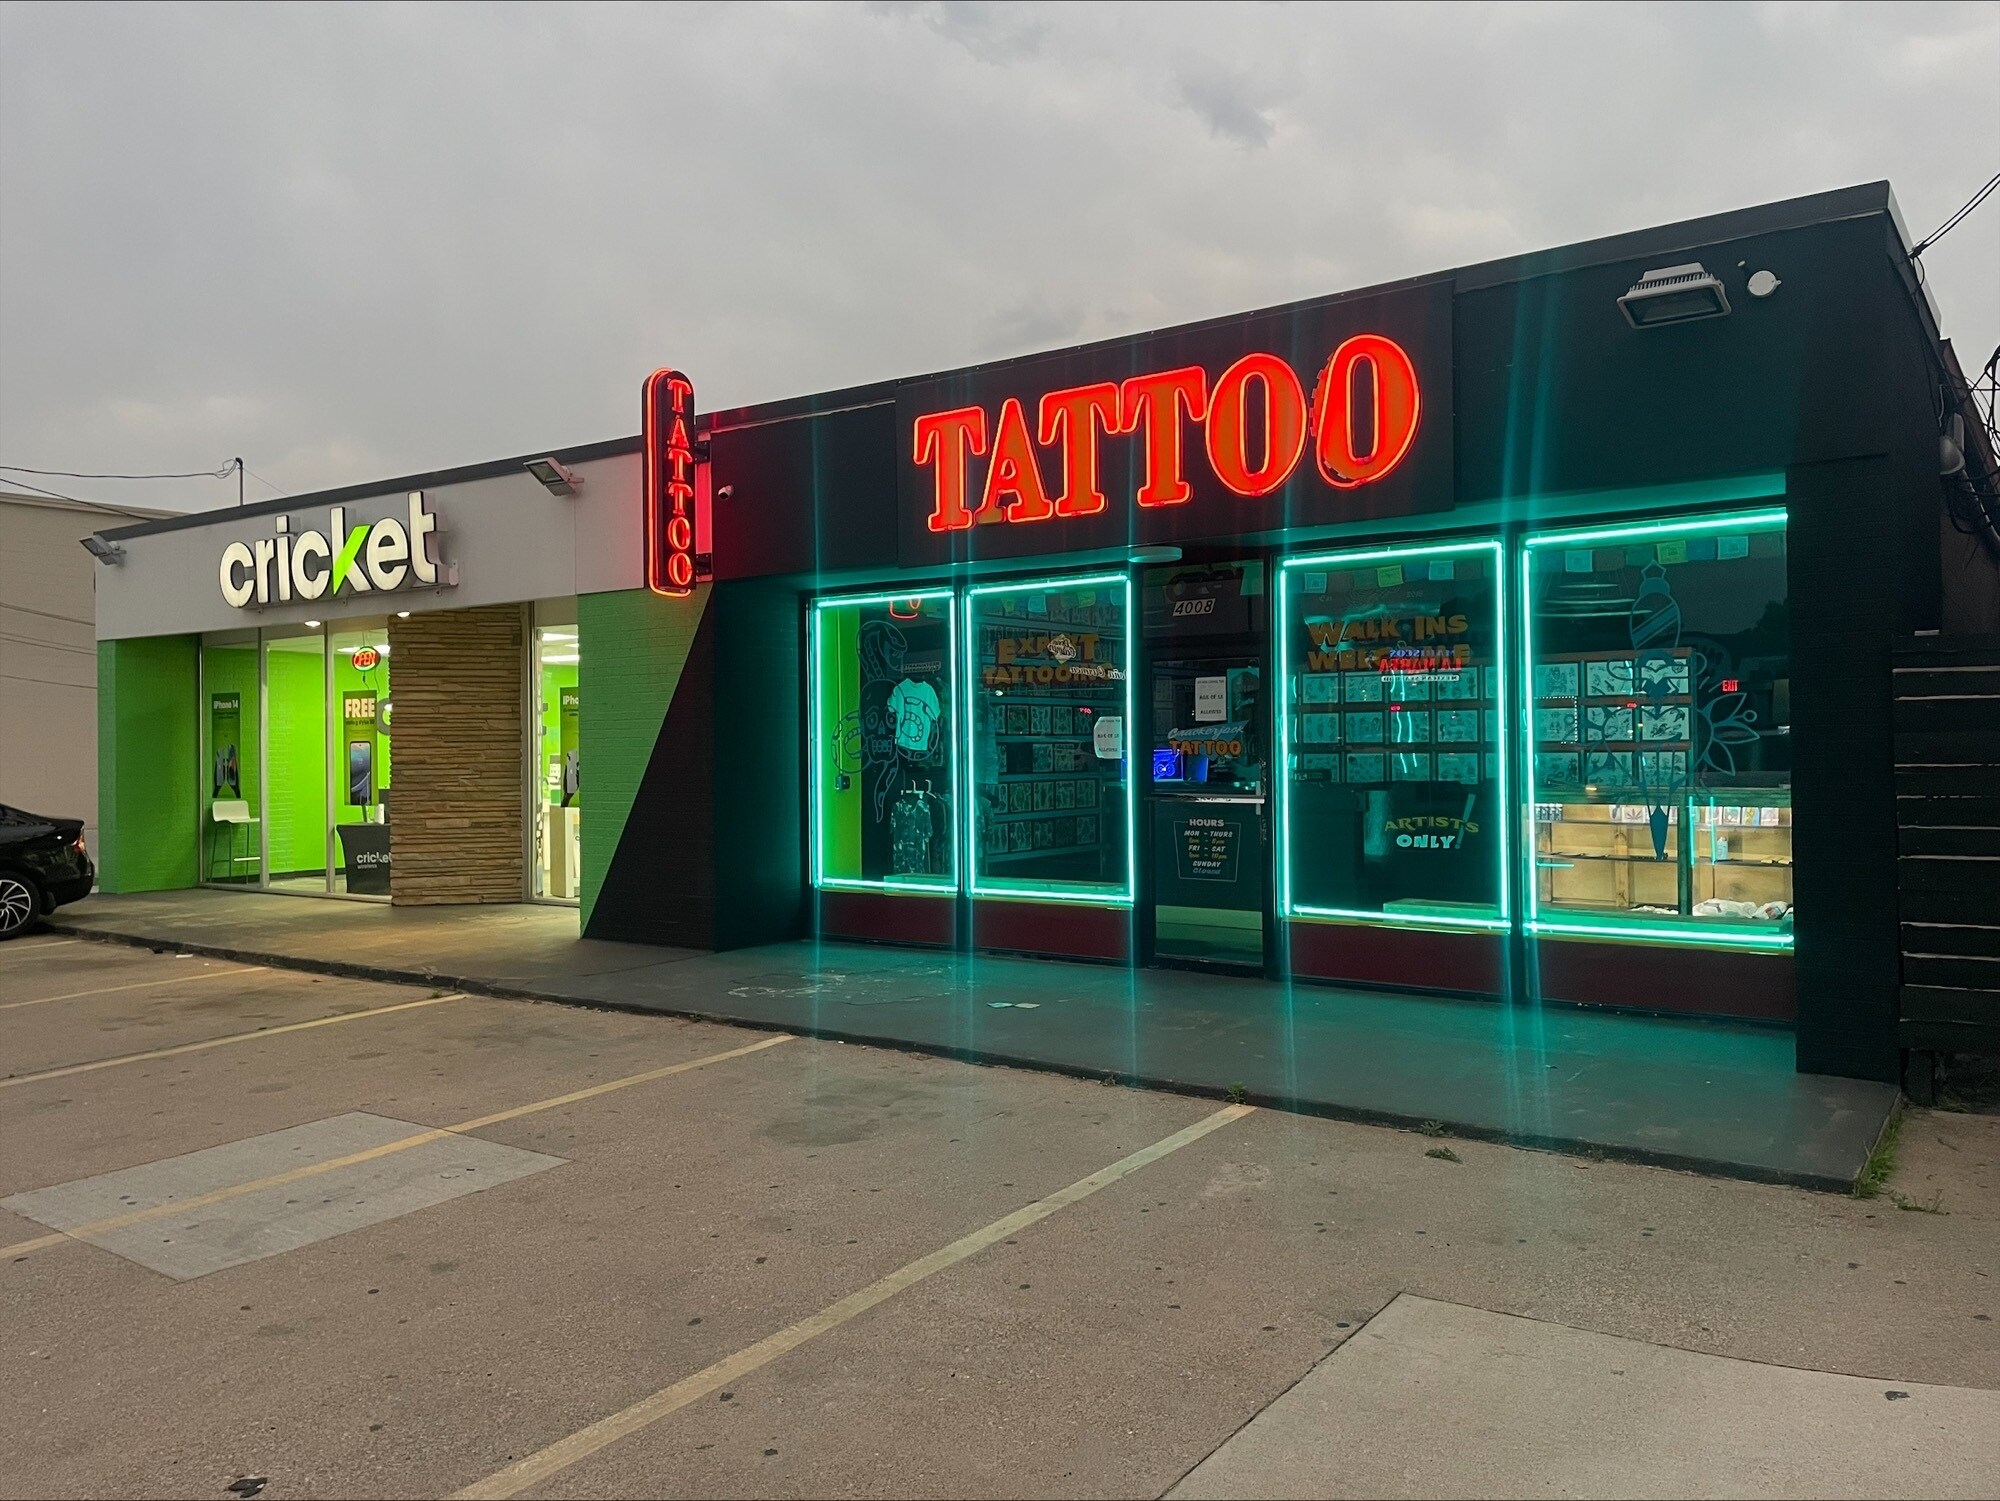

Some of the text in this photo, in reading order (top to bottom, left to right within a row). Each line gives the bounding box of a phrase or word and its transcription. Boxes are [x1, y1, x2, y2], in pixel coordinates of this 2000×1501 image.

[914, 334, 1421, 532] TATTOO
[667, 378, 693, 586] TATTOO
[219, 490, 438, 609] cricket
[1175, 600, 1213, 614] 4008
[353, 651, 376, 667] OPEN
[1722, 679, 1739, 692] EXIT
[345, 698, 376, 718] FREE
[1170, 740, 1241, 757] TATTOO
[1189, 819, 1224, 827] HOURS
[1384, 816, 1480, 833] ARTISTS
[1210, 830, 1233, 838] THURS
